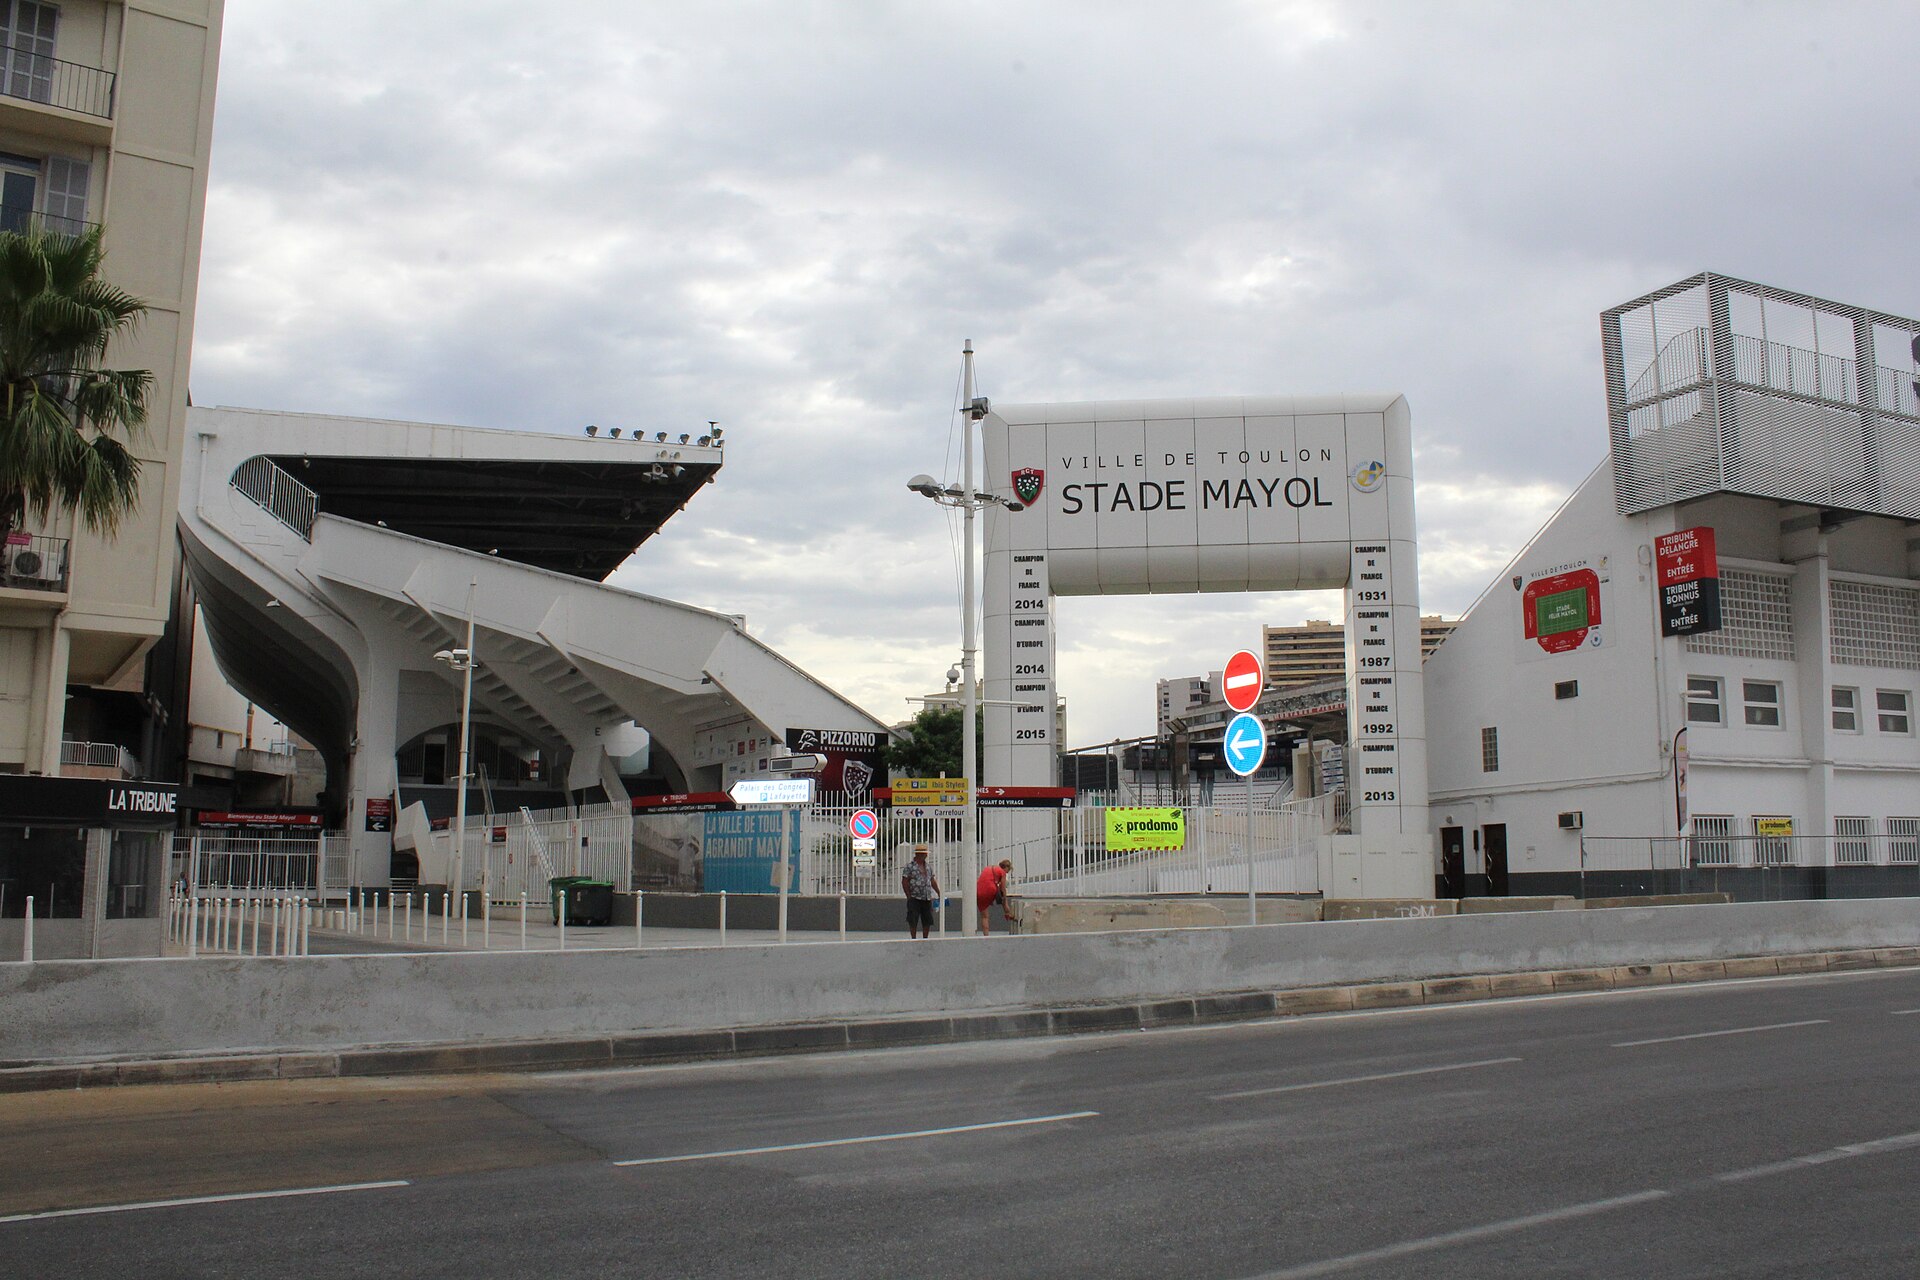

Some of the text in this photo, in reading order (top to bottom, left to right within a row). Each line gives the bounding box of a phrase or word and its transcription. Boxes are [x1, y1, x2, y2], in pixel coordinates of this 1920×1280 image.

[1062, 448, 1331, 470] VILLE DE TOULON
[1062, 477, 1332, 514] STADE MAYOL
[1662, 530, 1695, 546] TRIBUNE
[1660, 538, 1699, 556] DELANGRE
[1025, 568, 1033, 576] DE
[1530, 568, 1548, 578] VILLE
[1559, 560, 1587, 571] TOULON
[1667, 563, 1695, 578] ENTRÉE
[1666, 580, 1699, 596] TRIBUNE
[1357, 591, 1387, 601] 1931
[1666, 590, 1700, 605] BONNUS
[1015, 599, 1044, 609] 2014
[1555, 604, 1570, 613] STADE
[1357, 611, 1389, 619] CHAMPION
[1561, 608, 1577, 617] MAYOL
[1014, 619, 1045, 627] CHAMPION
[1670, 613, 1699, 628] ENTRÉE
[1016, 640, 1043, 648] D'EUROPE
[1363, 638, 1386, 646] FRANCE
[1360, 657, 1391, 667] 1987
[1015, 664, 1045, 674] 2014
[1360, 677, 1392, 685] CHAMPION
[1015, 684, 1046, 692] CHAMPION
[1372, 691, 1381, 699] DE
[1366, 705, 1389, 713] FRANCE
[595, 727, 601, 737] E
[1362, 723, 1394, 734] 1992
[820, 730, 876, 747] PIZZORNO
[1016, 729, 1046, 739] 2015
[820, 745, 876, 753] ENVIRONNEMENT
[1362, 744, 1395, 752] CHAMPION
[1365, 766, 1393, 774] D'EUROPE
[740, 784, 760, 792] Palais
[763, 783, 775, 791] des
[946, 781, 965, 790] Styles
[109, 788, 177, 813] LA TRIBUNE
[769, 793, 807, 801] Lafayette
[895, 795, 931, 805] Ibis Budget
[1364, 791, 1395, 801] 2013
[934, 808, 965, 817] Carrefour
[706, 814, 794, 834] LA VILLE DE TOULN
[1126, 818, 1178, 834] prodomo
[706, 836, 795, 858] AGRANDIT MAYL
